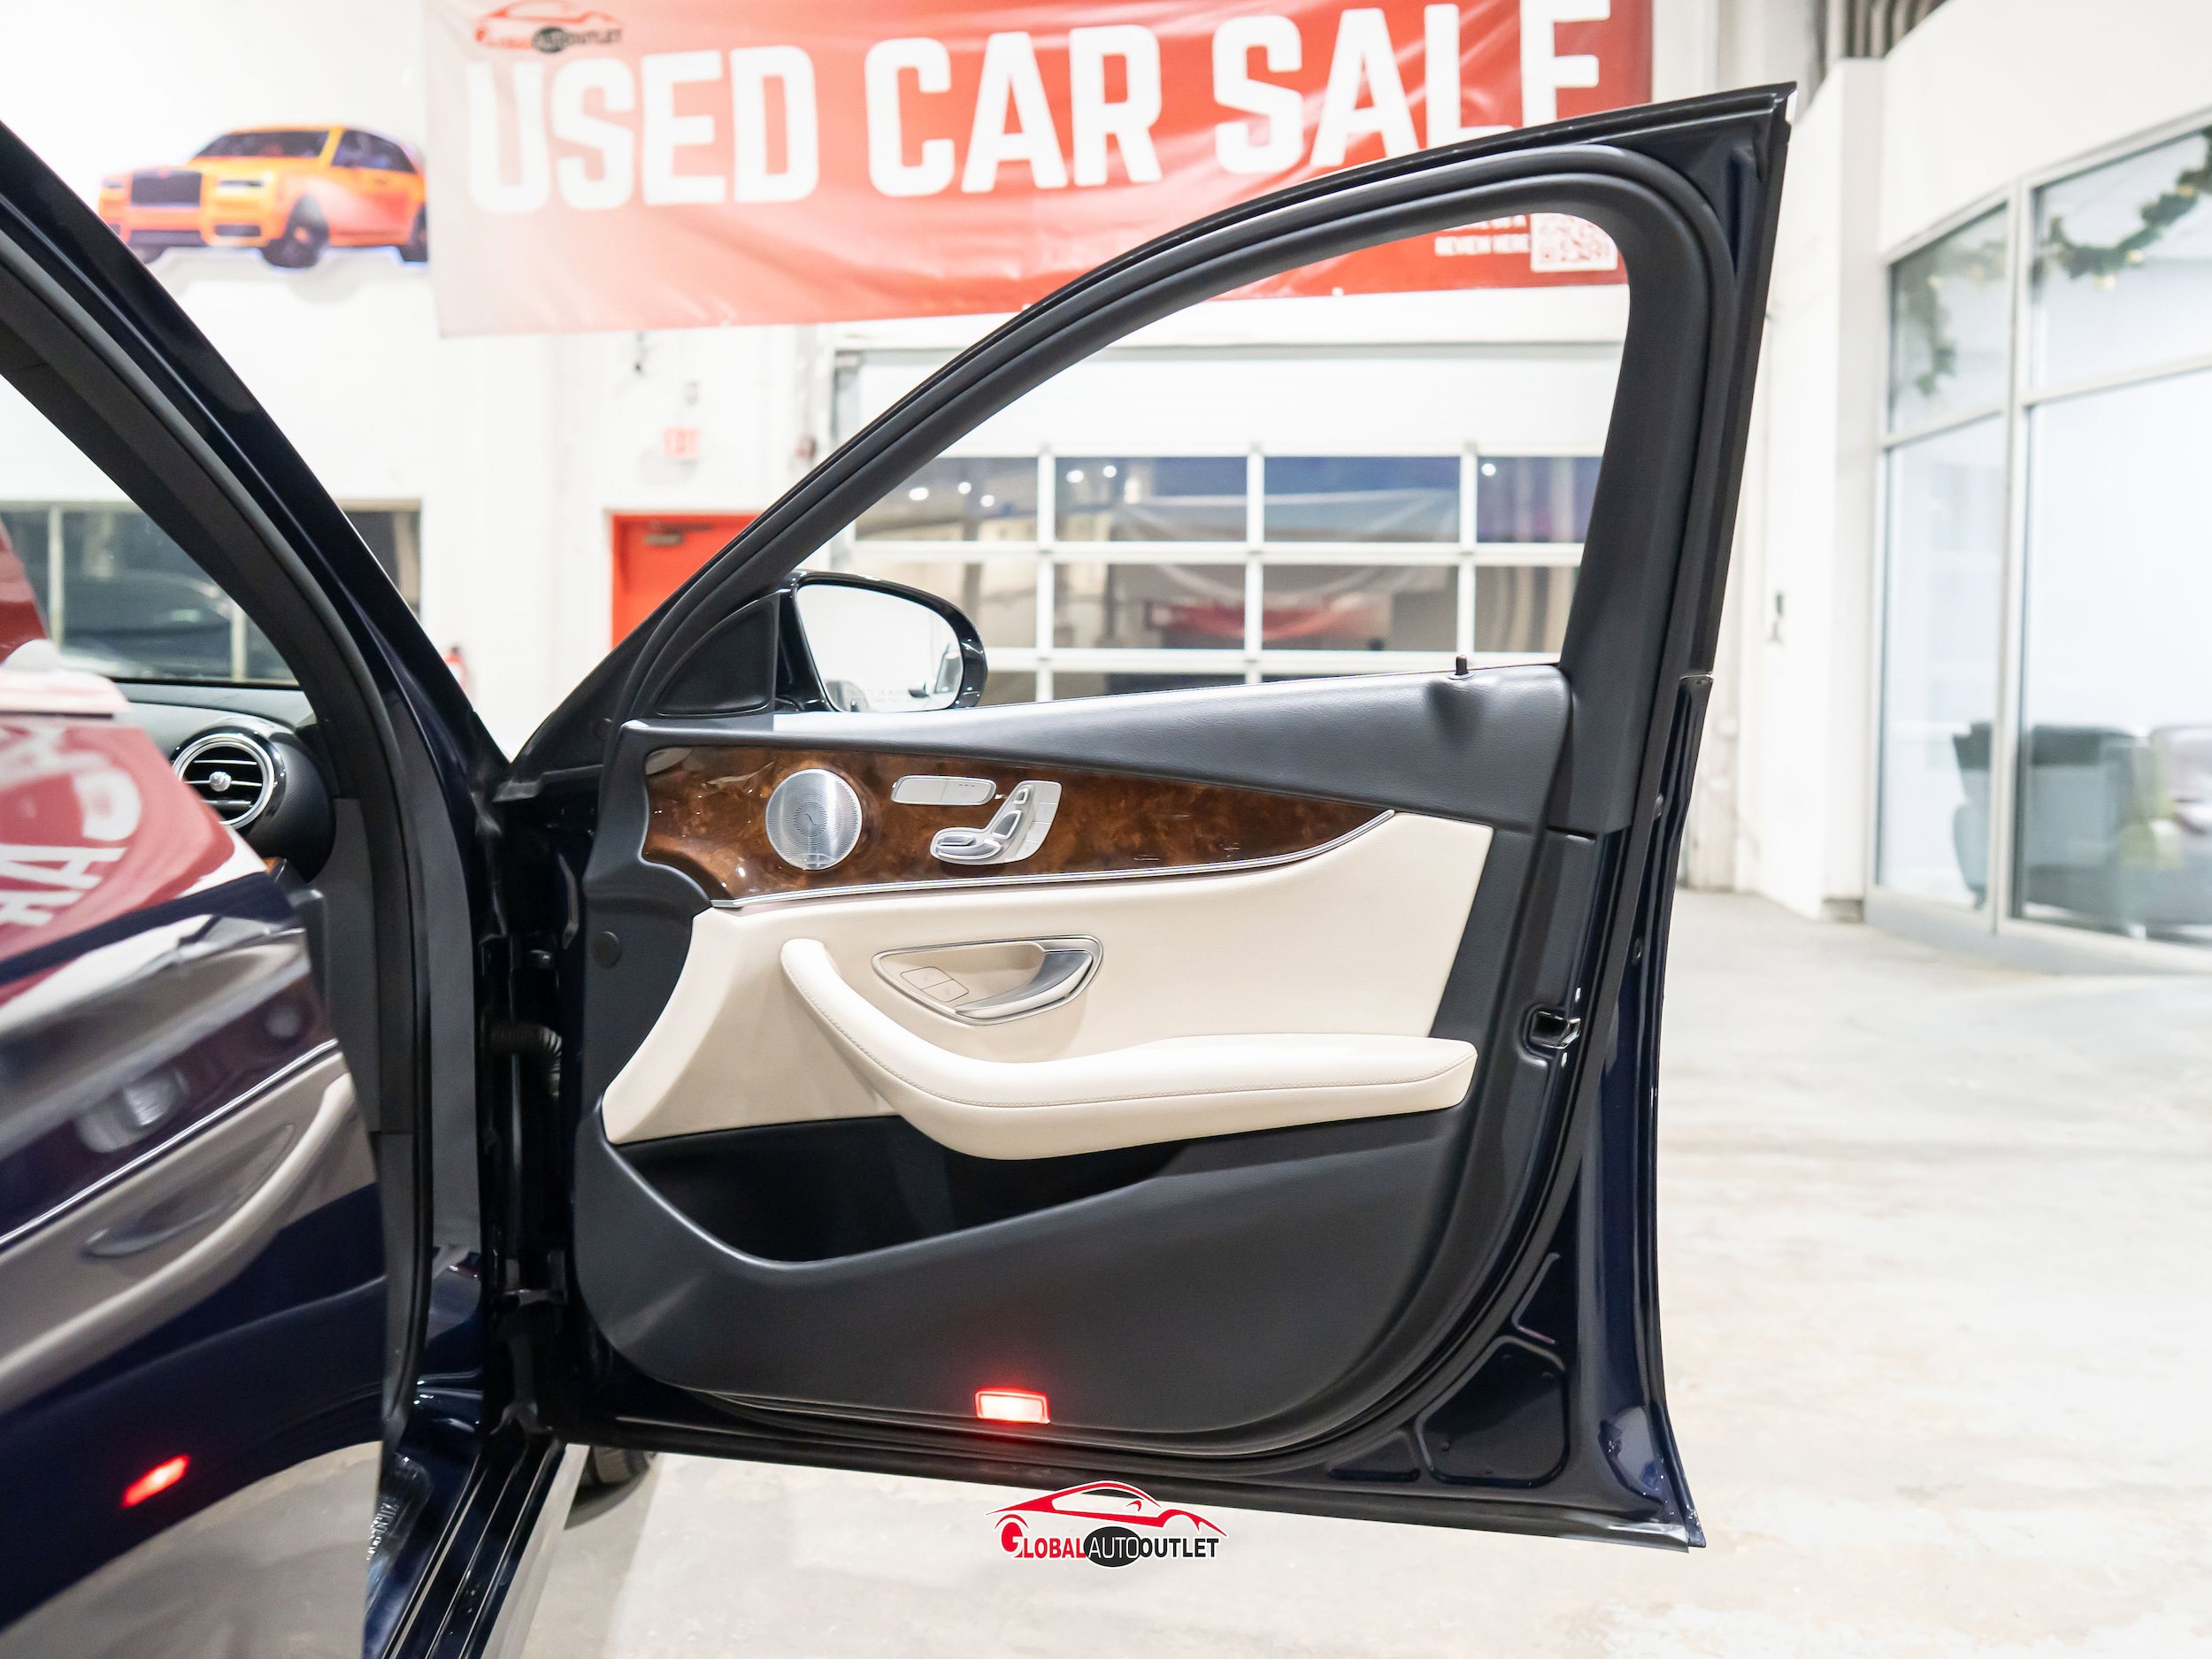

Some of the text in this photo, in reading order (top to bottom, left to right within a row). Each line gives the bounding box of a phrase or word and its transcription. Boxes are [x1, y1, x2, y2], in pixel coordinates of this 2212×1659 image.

[465, 0, 1610, 212] USED CAR SALE
